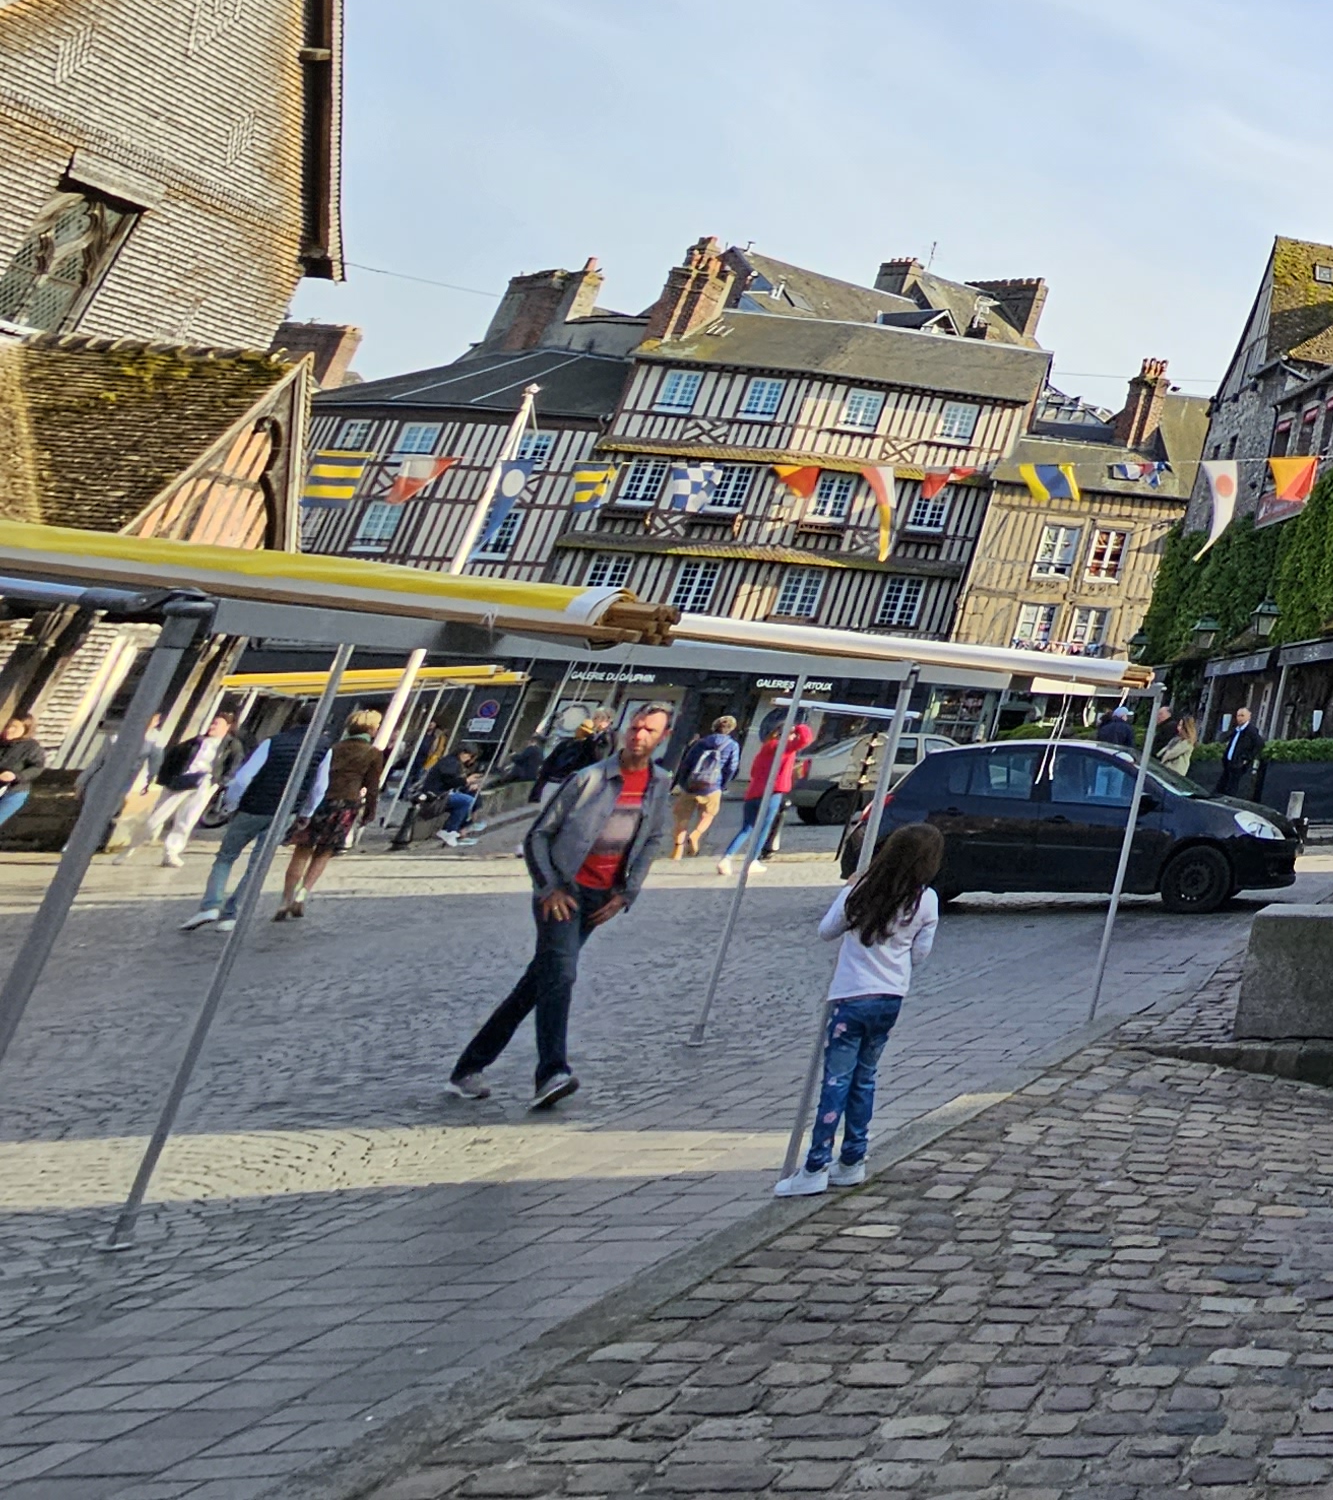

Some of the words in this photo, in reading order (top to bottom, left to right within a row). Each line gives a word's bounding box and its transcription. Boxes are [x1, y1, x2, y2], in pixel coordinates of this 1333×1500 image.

[571, 671, 606, 680] GALERIE
[606, 672, 621, 681] DU
[756, 679, 795, 689] GALERIES
